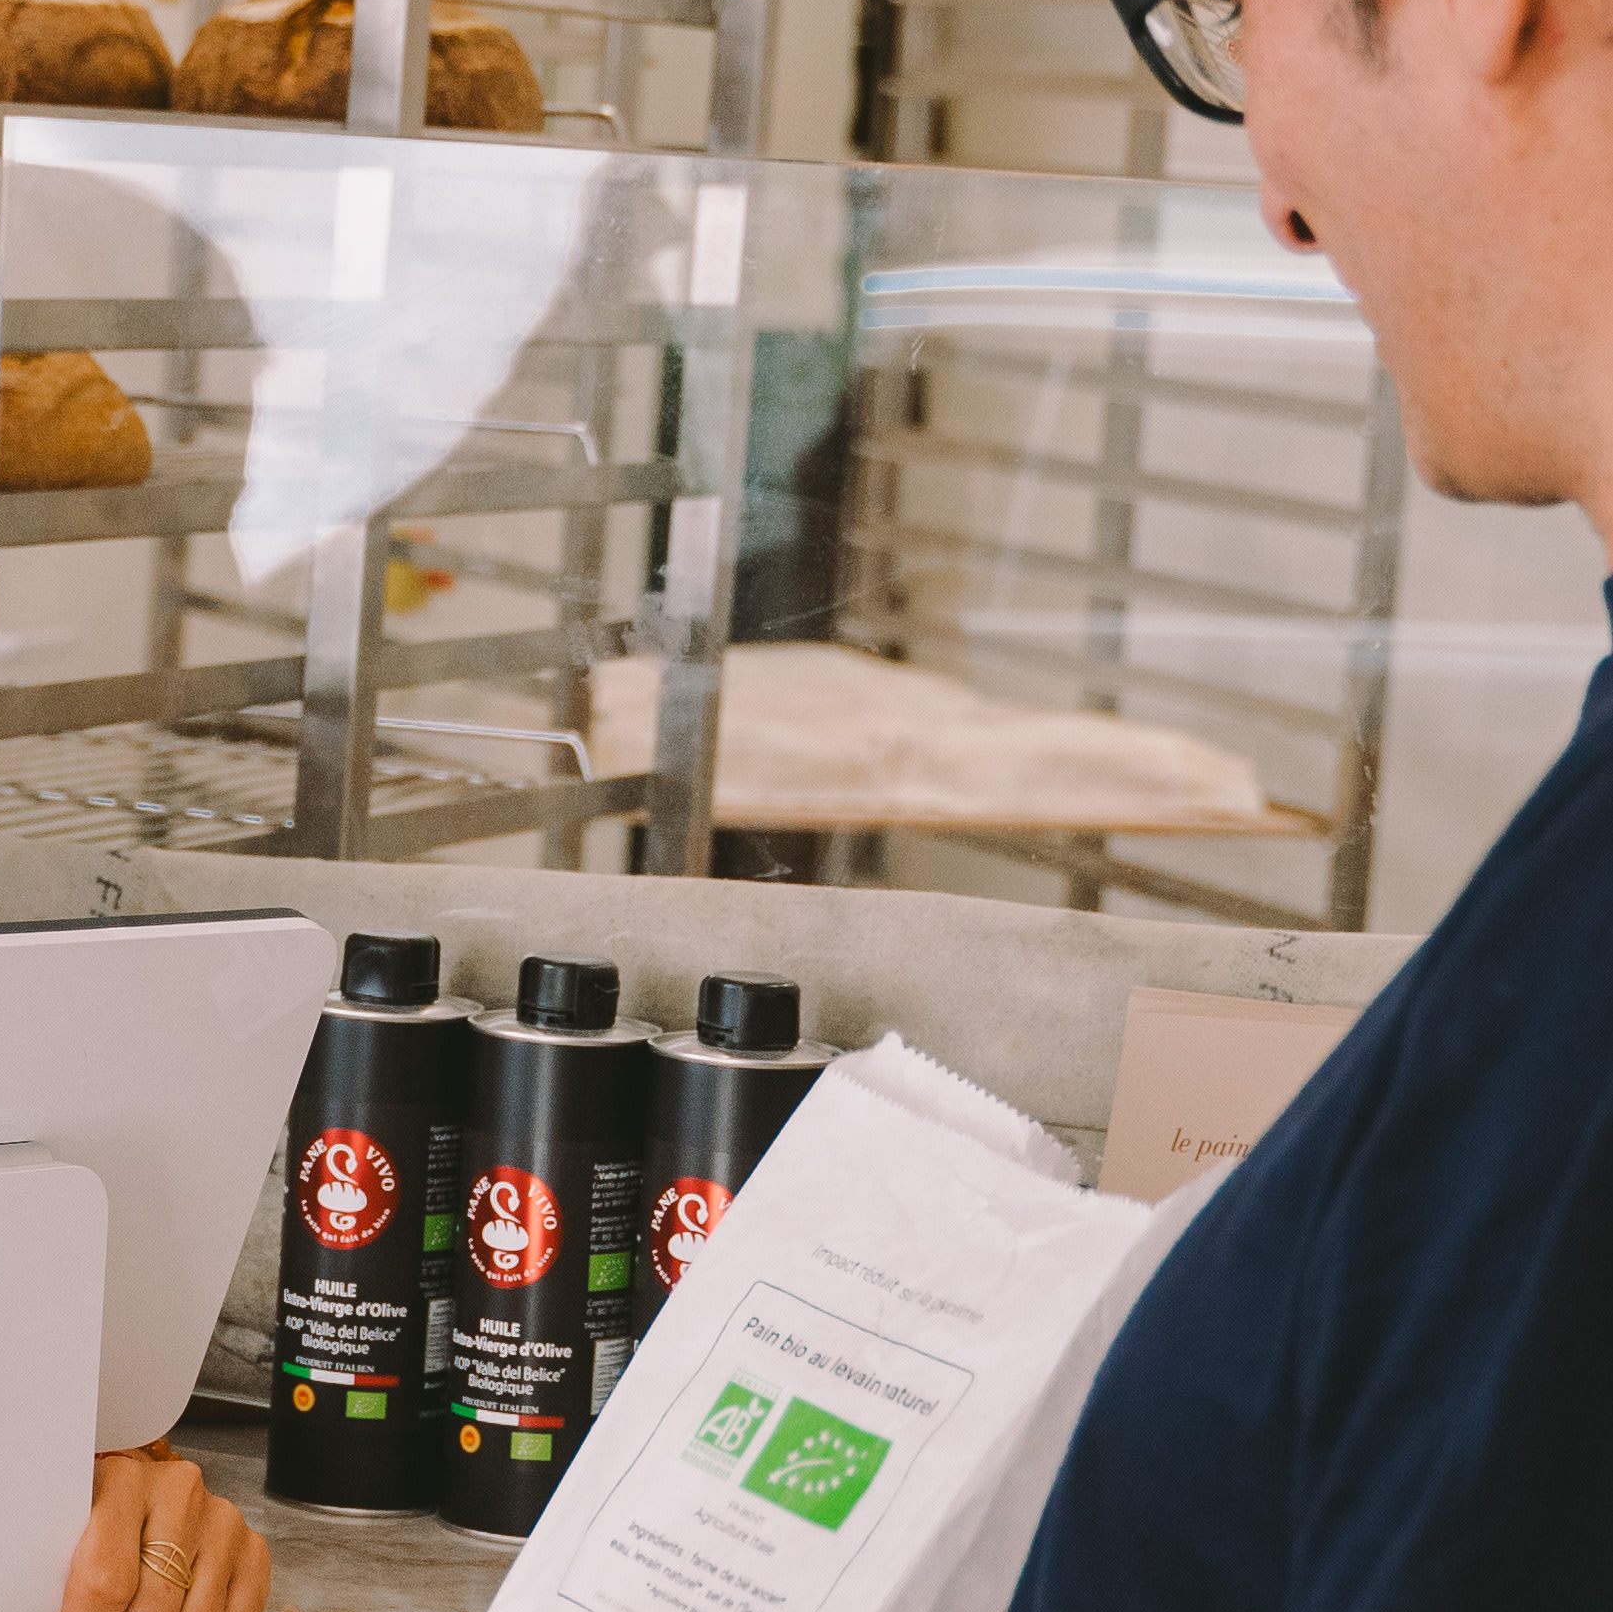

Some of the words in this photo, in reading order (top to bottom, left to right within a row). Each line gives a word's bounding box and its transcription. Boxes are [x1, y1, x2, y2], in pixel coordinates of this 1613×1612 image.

[1171, 1127, 1191, 1153] le
[1194, 1134, 1250, 1162] pain
[299, 1138, 328, 1182] PANE
[366, 1145, 395, 1192] VIVO
[467, 1175, 492, 1221] PANE
[527, 1184, 557, 1230] VIVO
[650, 1187, 679, 1232] PANE
[812, 1244, 860, 1276] Impact
[859, 1265, 900, 1293] réduit
[314, 1278, 357, 1298] HUILE
[356, 1301, 408, 1318] d'Olive
[338, 1325, 357, 1338] del
[479, 1317, 521, 1338] HUILE
[302, 1333, 370, 1356] Biologique
[519, 1341, 572, 1359] d'Olive
[742, 1317, 780, 1346] Pain
[779, 1334, 808, 1359] bio
[808, 1351, 830, 1370] au
[829, 1357, 882, 1393] levain
[335, 1362, 376, 1373] ITALIEN
[502, 1364, 521, 1378] del
[468, 1373, 534, 1396] Biologique
[500, 1402, 539, 1414] ITALIEN
[699, 1405, 751, 1451] AB
